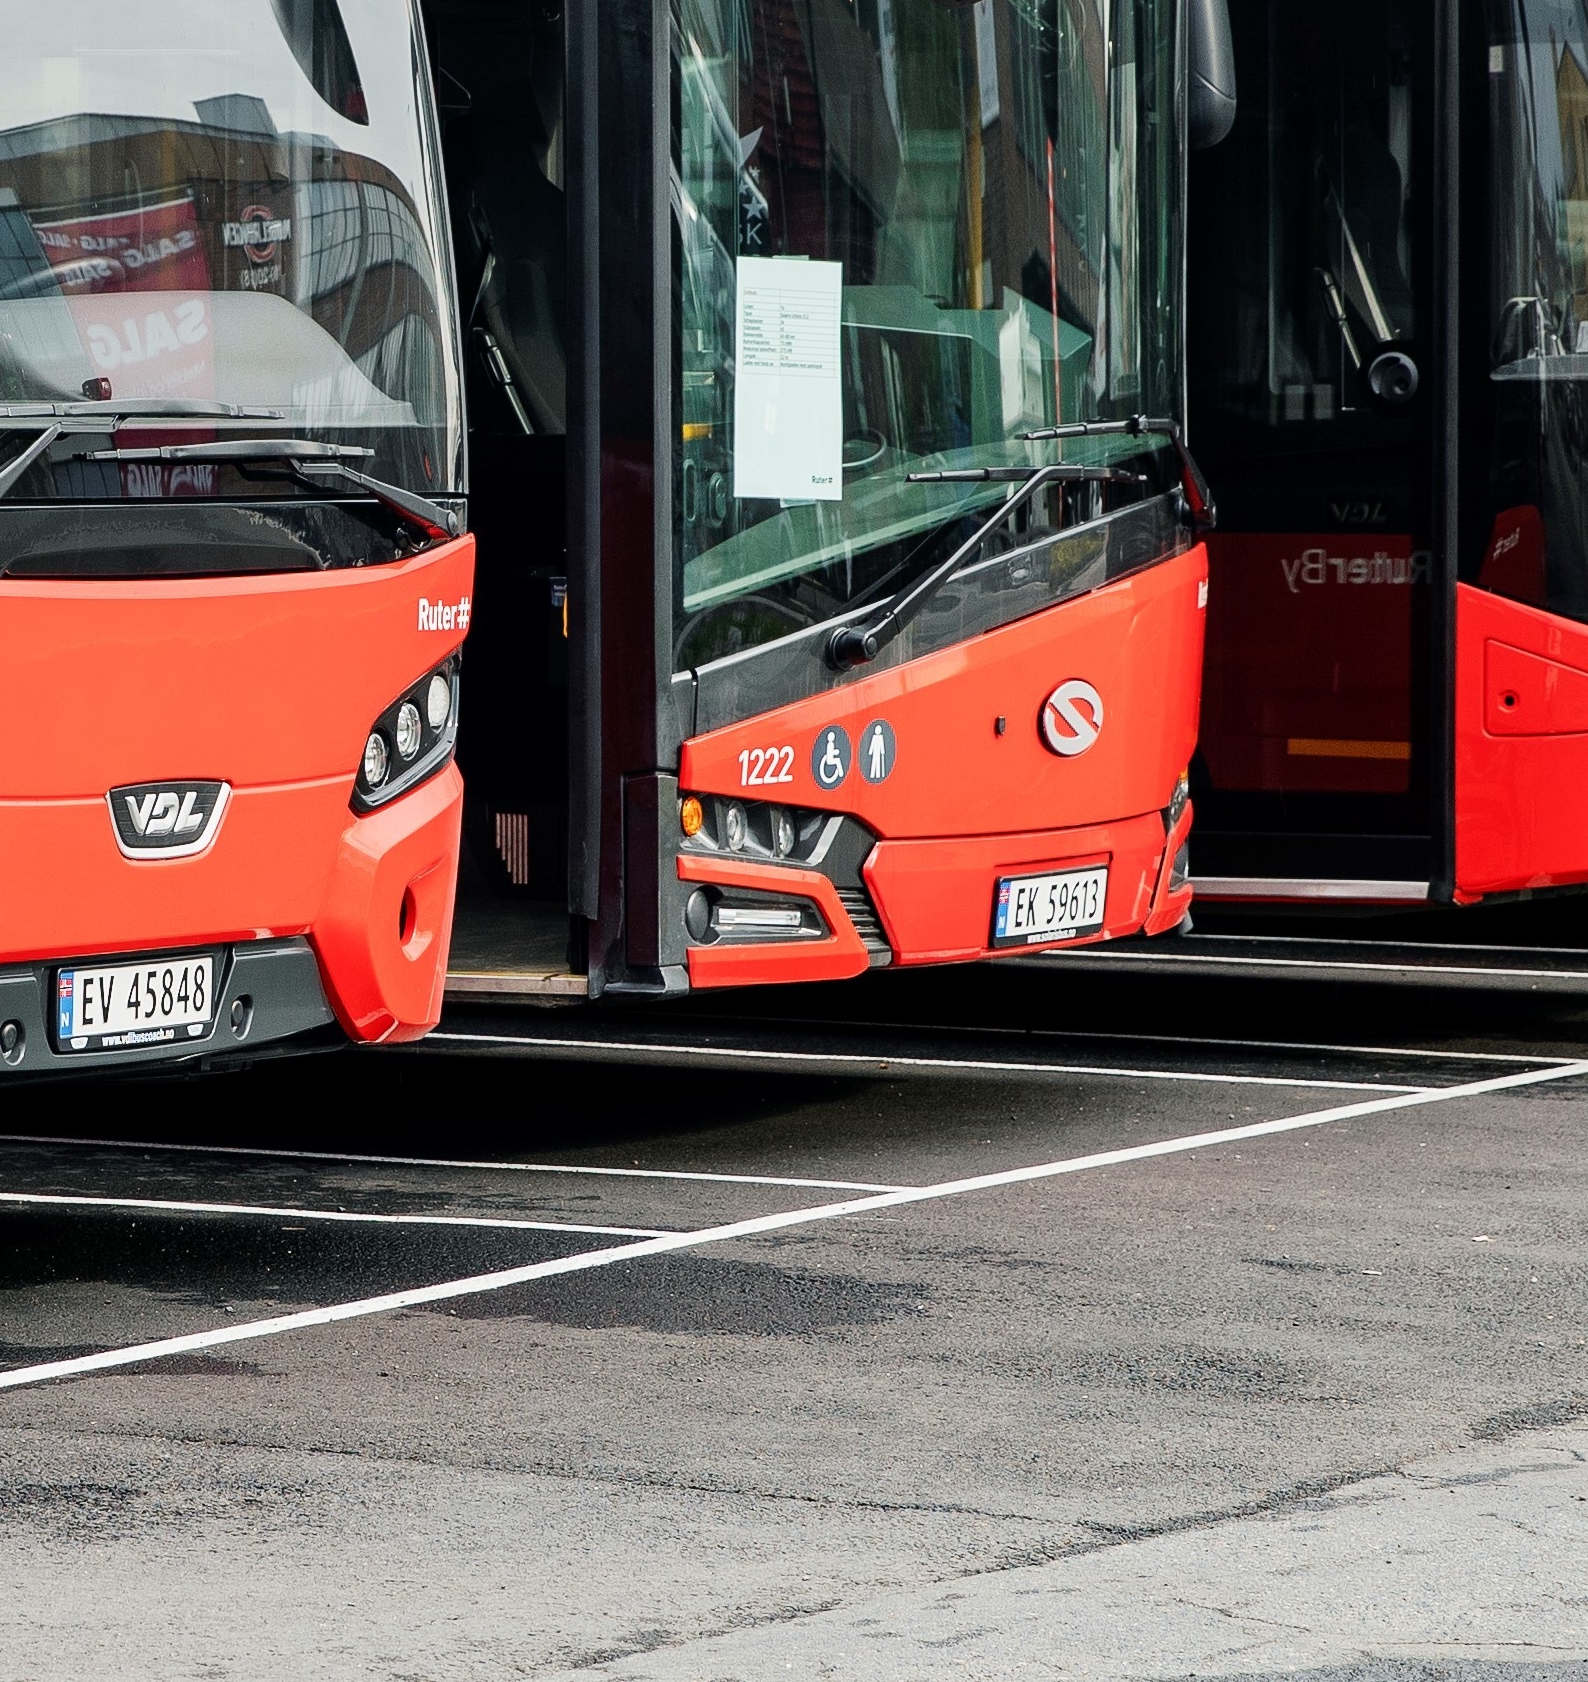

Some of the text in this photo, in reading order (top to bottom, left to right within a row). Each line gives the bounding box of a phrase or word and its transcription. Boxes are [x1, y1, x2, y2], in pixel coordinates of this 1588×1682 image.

[417, 595, 471, 633] Ruter#
[738, 743, 795, 788] 1222
[125, 790, 207, 836] VDL
[1014, 885, 1040, 929] EK
[1046, 878, 1099, 926] 59613
[60, 964, 206, 1028] N EV 45848
